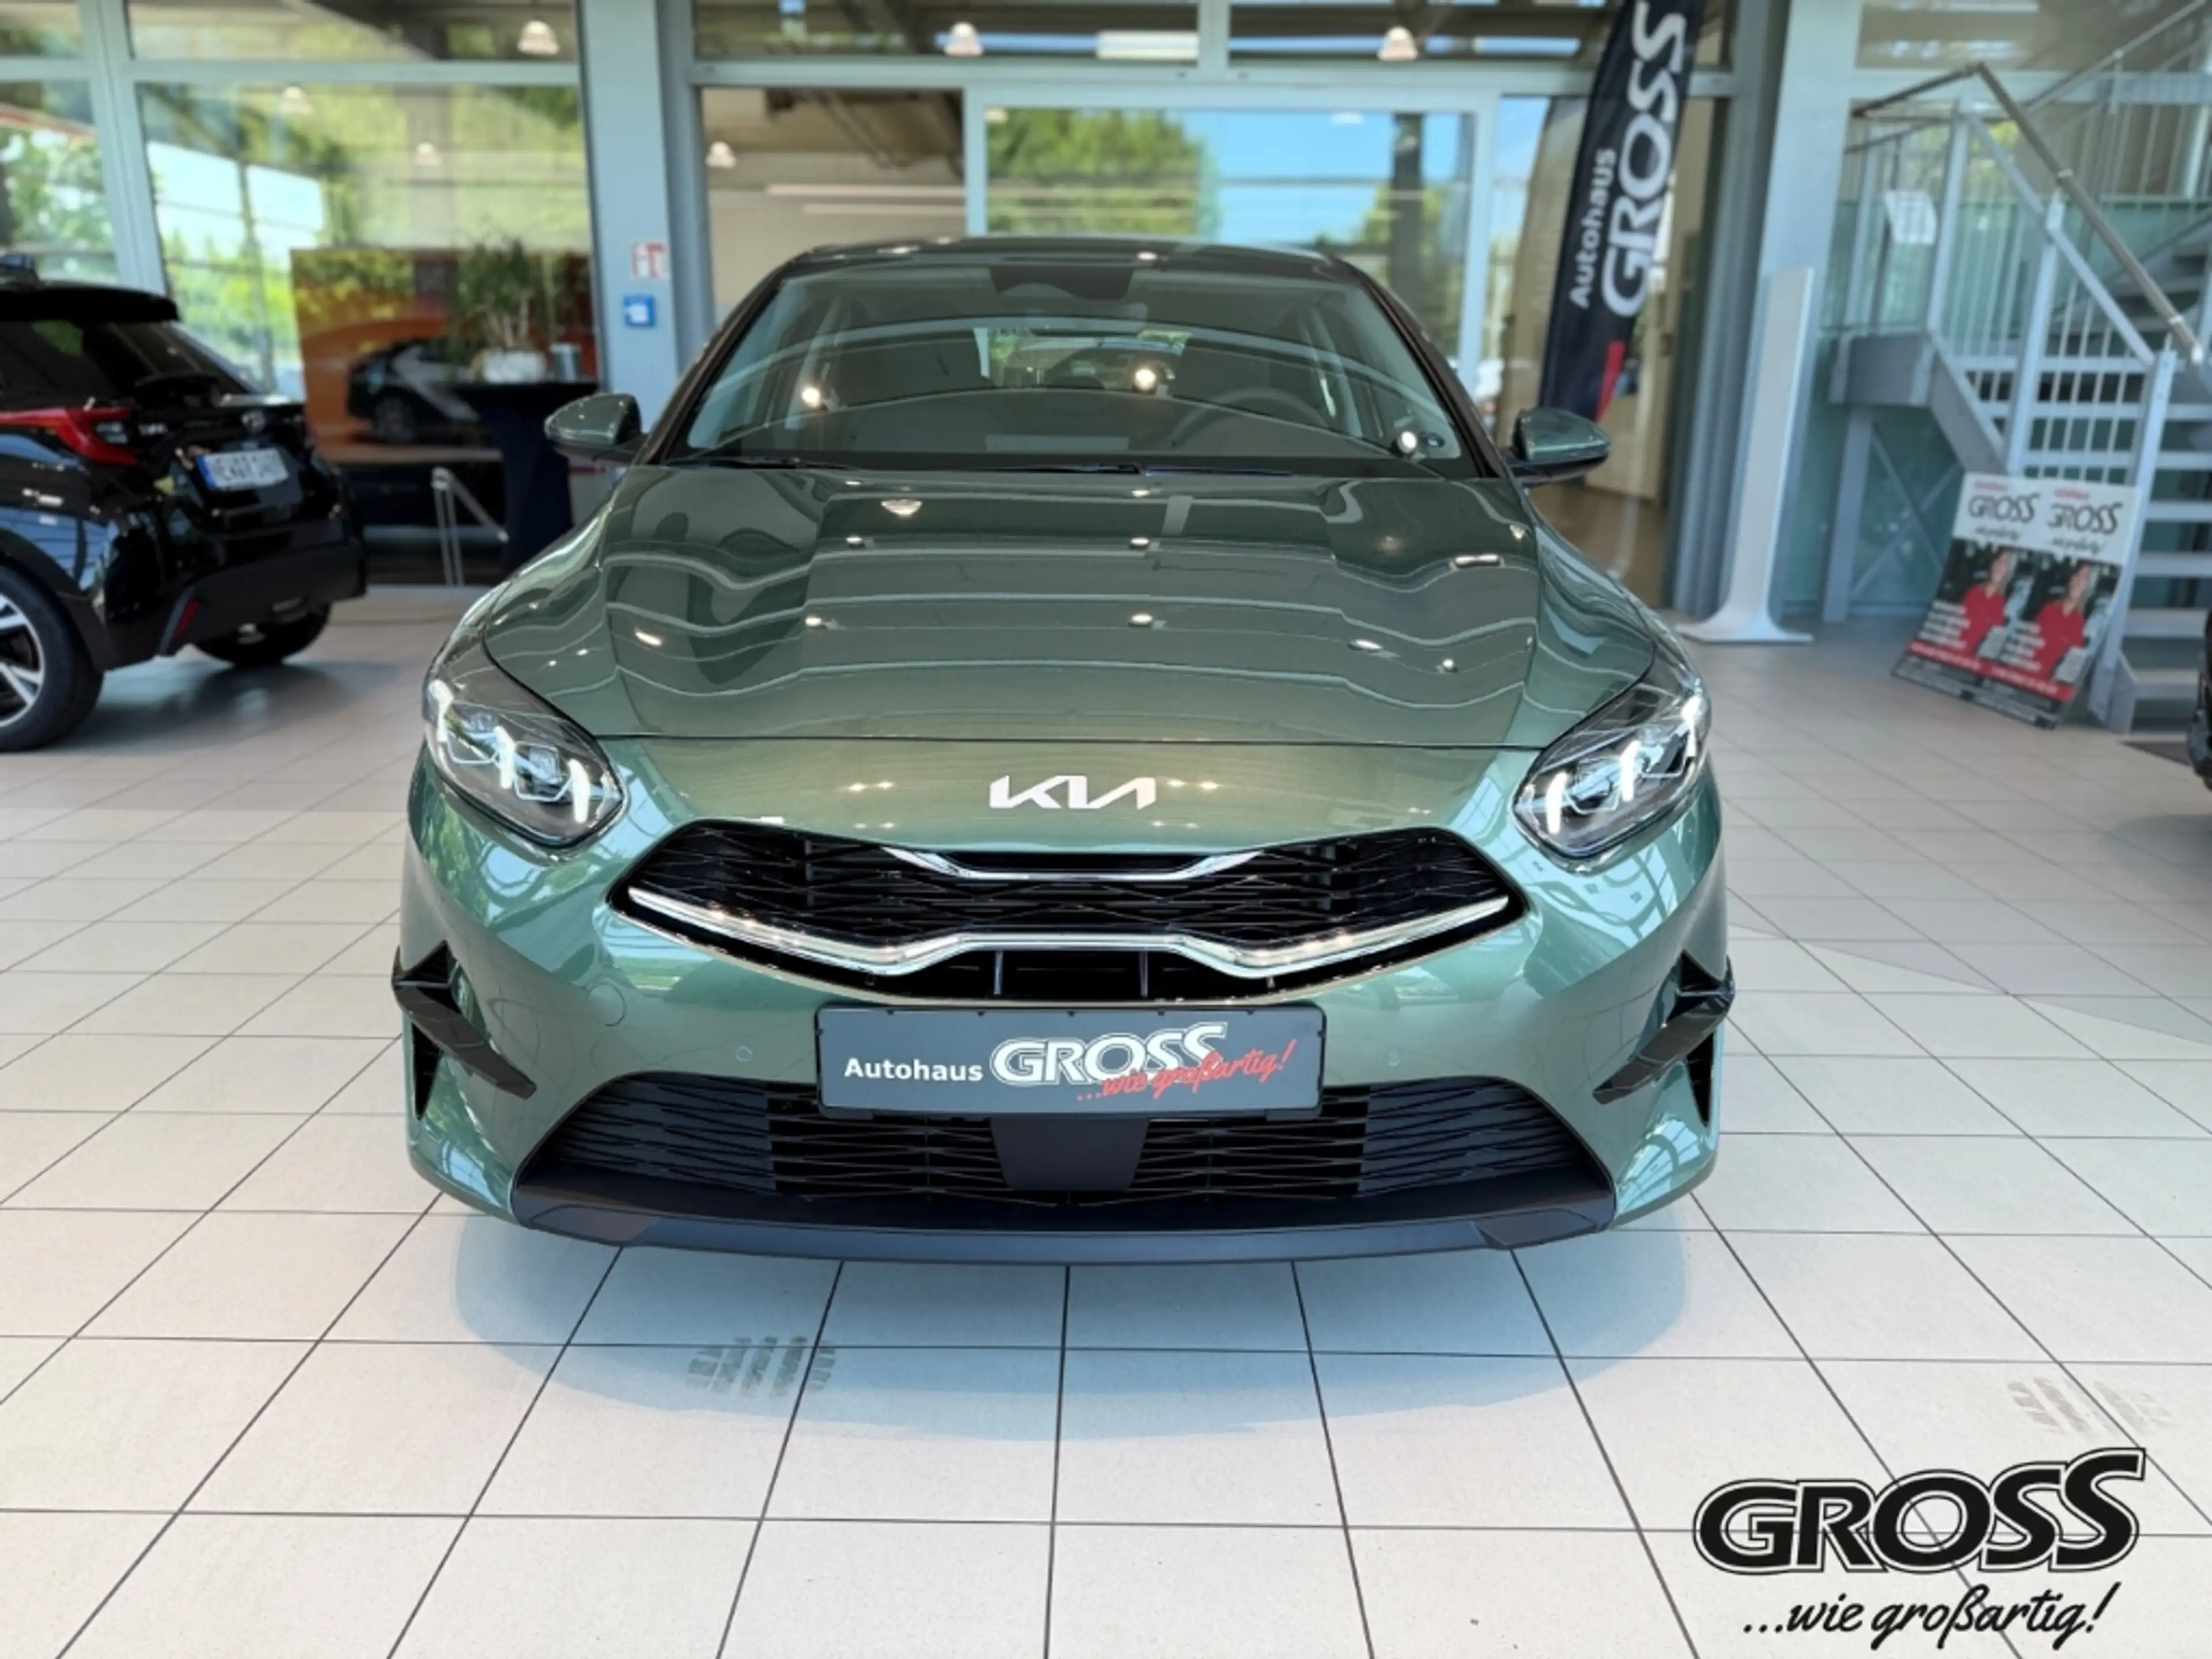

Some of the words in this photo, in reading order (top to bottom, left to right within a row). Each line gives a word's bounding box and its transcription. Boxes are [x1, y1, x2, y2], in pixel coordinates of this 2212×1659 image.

[1601, 1, 1687, 317] GROSS
[1569, 147, 1616, 309] Autohaus
[1968, 491, 2041, 524] GROSS
[989, 775, 1157, 810] KIA
[844, 1058, 984, 1081] Autohaus
[990, 1021, 1228, 1087] GROSS
[1151, 1038, 1297, 1101] großartig!
